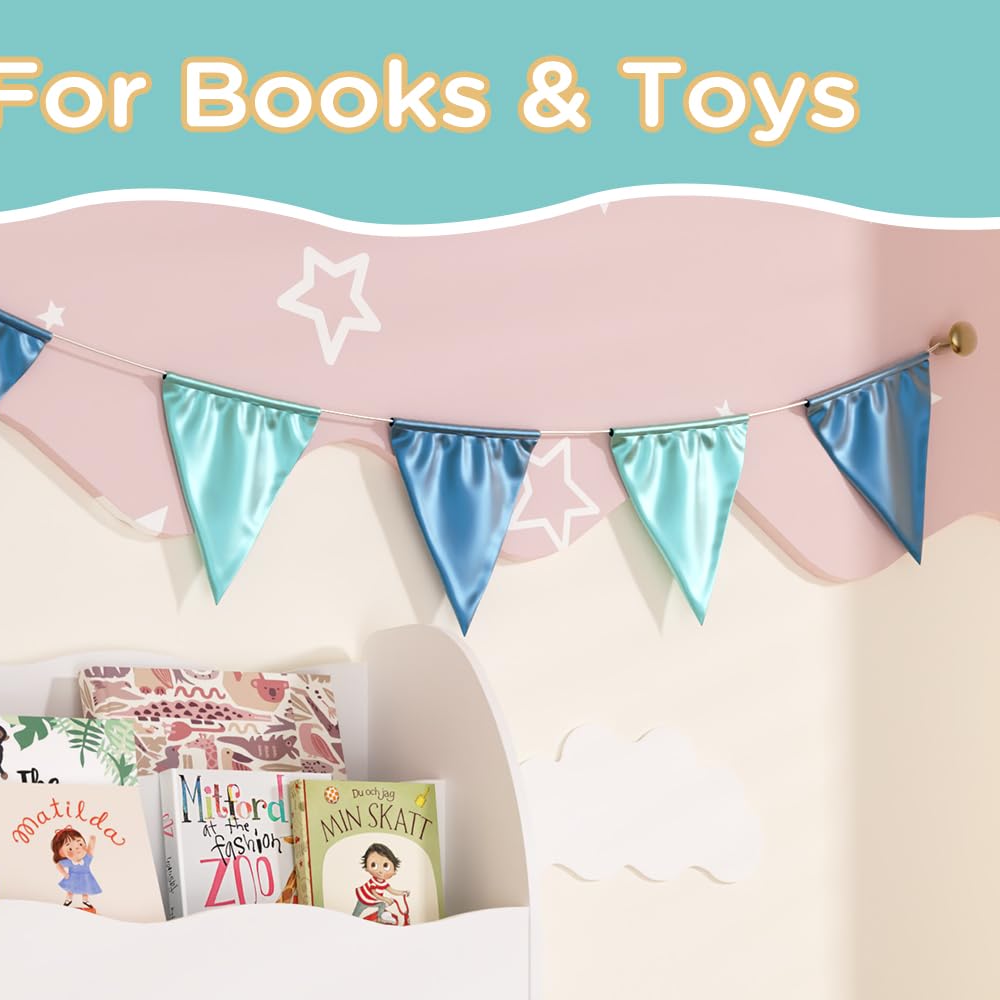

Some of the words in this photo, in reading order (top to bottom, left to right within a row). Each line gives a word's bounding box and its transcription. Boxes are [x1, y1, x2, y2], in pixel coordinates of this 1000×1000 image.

[179, 774, 289, 824] Mitford
[352, 789, 364, 799] Du
[366, 787, 380, 798] och
[378, 789, 396, 802] jag
[203, 820, 217, 837] at
[225, 818, 250, 835] the
[320, 805, 362, 842] MIN
[368, 802, 433, 840] SKATT
[211, 828, 282, 866] fashion
